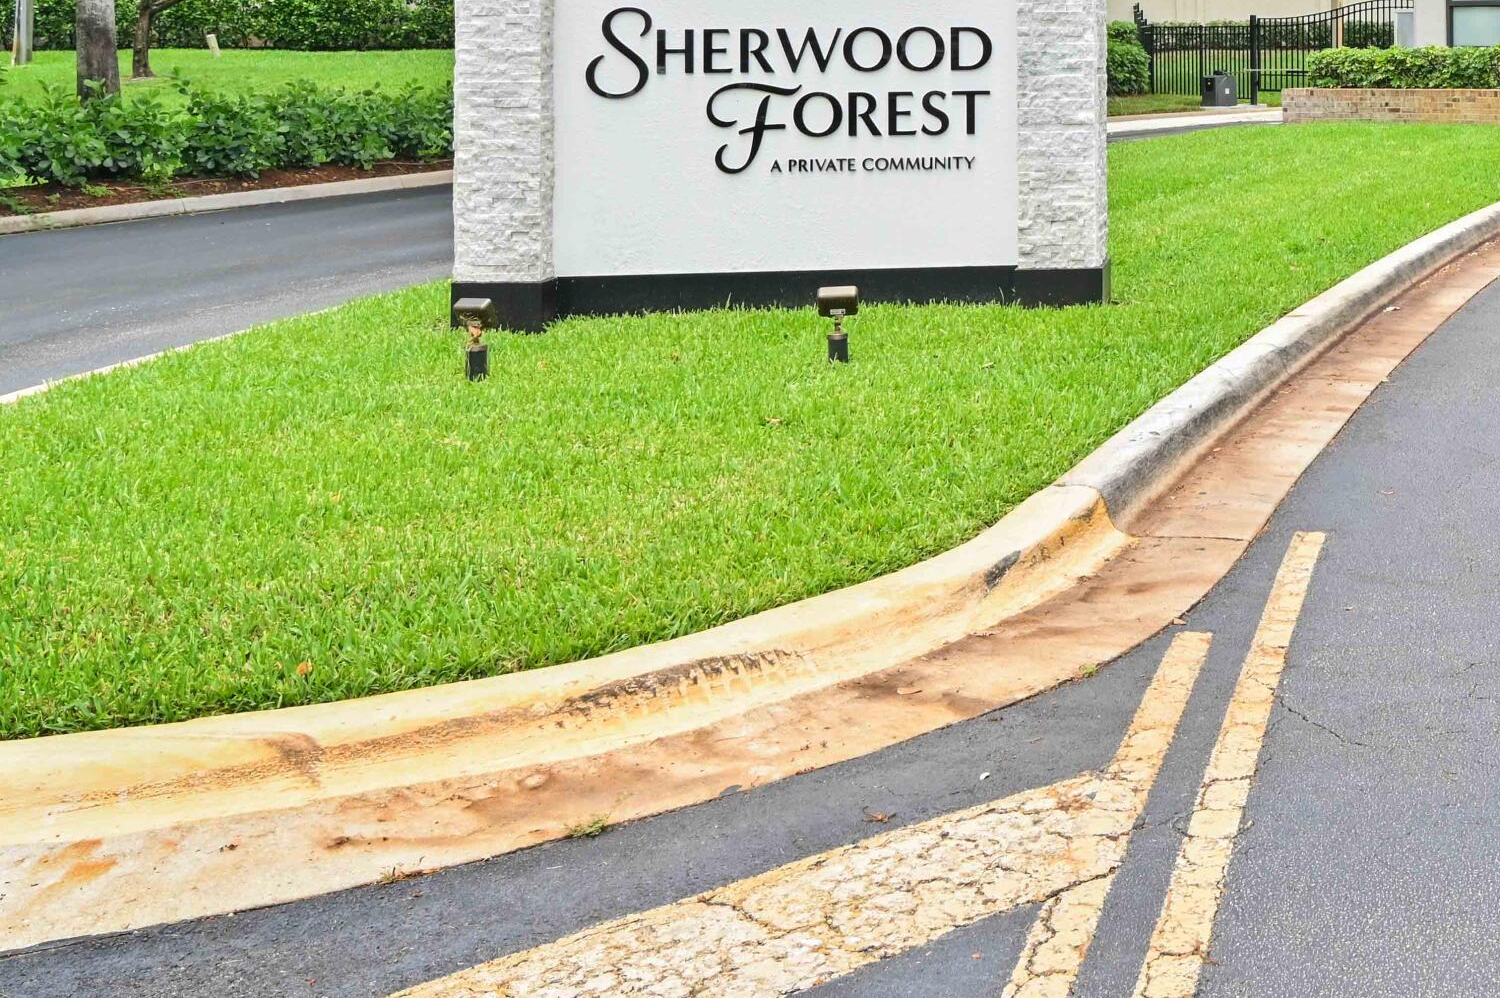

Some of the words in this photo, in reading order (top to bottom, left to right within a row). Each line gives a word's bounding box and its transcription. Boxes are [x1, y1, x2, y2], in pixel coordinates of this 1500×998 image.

[585, 7, 993, 99] SHERWOOD
[706, 82, 991, 175] FOREST
[770, 159, 783, 173] A
[787, 158, 857, 173] PRIVATE
[861, 156, 976, 172] COMMUNITY
